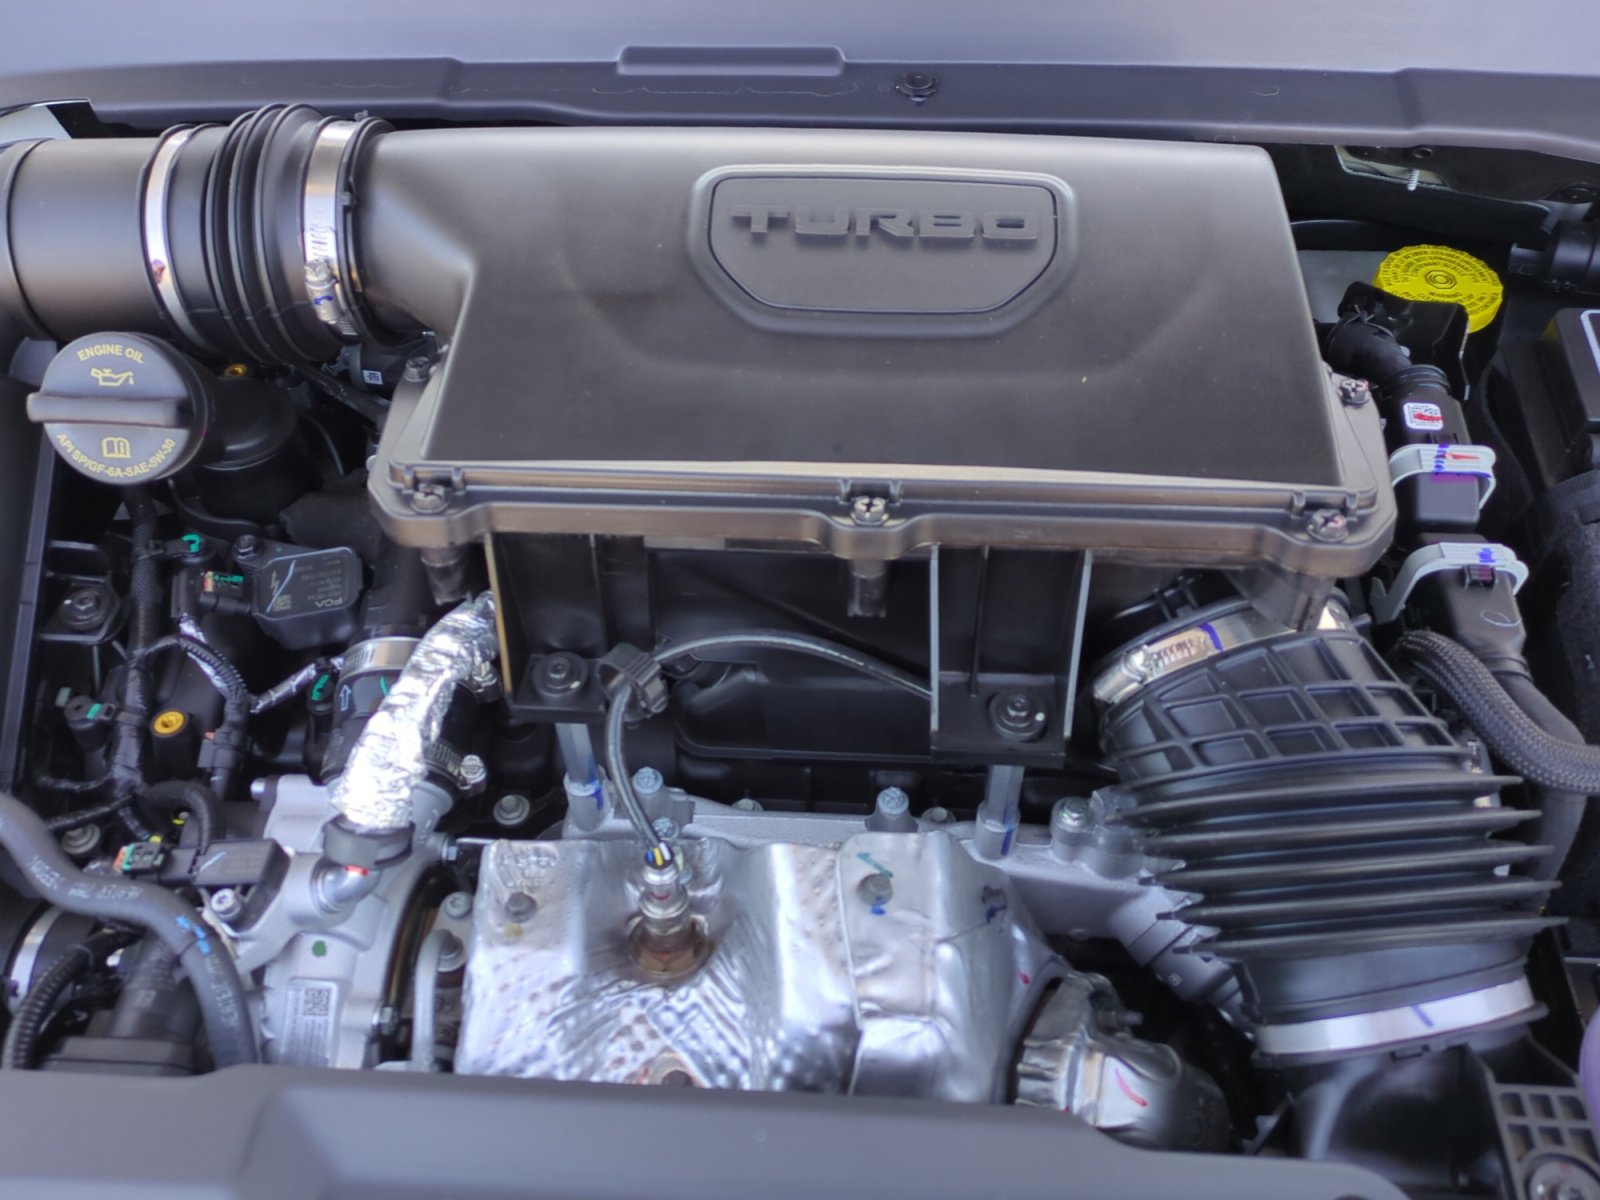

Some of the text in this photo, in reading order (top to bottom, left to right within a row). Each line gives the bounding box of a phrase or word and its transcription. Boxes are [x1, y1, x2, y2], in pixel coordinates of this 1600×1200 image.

[730, 206, 1038, 244] TURBO
[77, 344, 144, 364] ENGINE OIL
[56, 433, 76, 453] API
